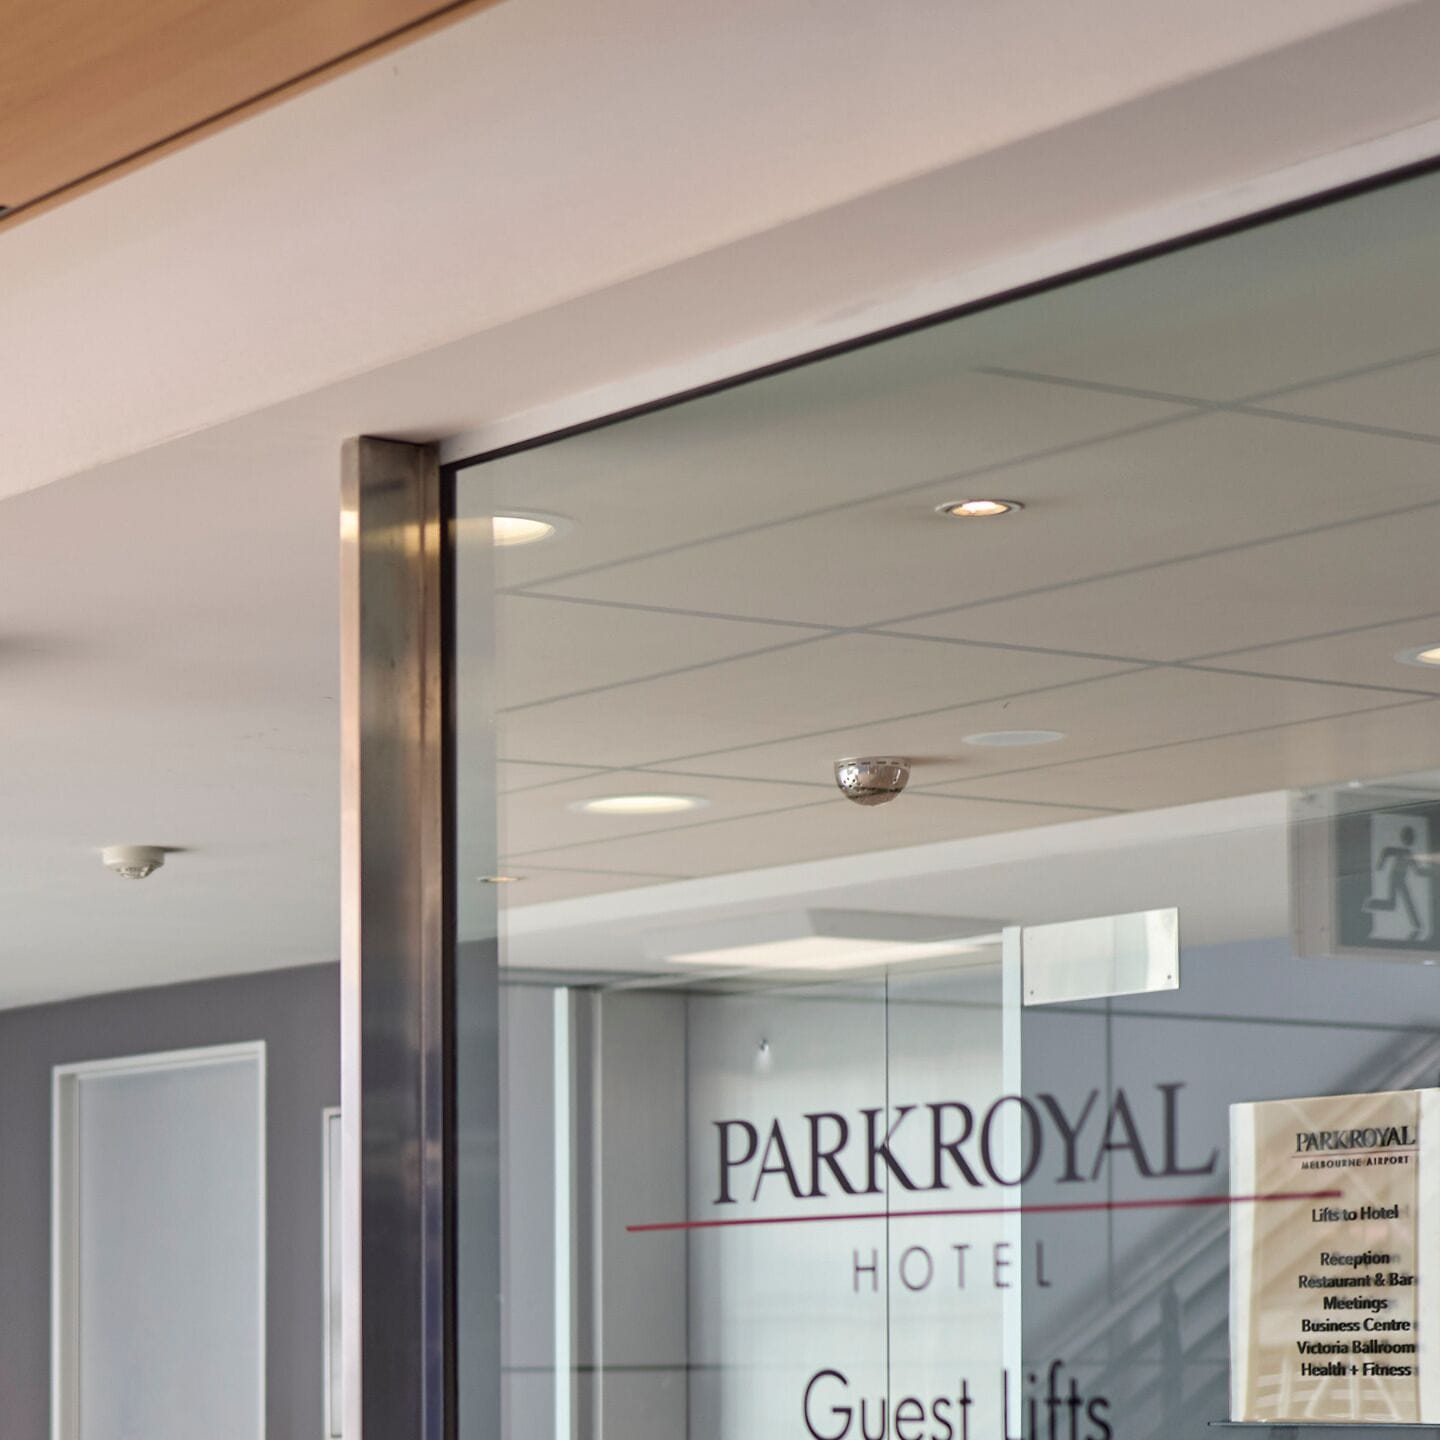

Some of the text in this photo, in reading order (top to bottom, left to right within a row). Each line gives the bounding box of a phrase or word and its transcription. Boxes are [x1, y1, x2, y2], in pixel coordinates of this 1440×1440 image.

[713, 1082, 1220, 1204] PARKROYAL
[1296, 1126, 1416, 1152] PARKROYAL
[1301, 1155, 1409, 1169] MELBOURNE AIRPORT
[1311, 1204, 1399, 1223] Lifts to Hotel
[852, 1240, 1053, 1293] HOTEL
[1320, 1250, 1391, 1269] Reception
[1298, 1272, 1414, 1288] Restaurant & Bar
[1323, 1295, 1389, 1313] Meetings
[1302, 1317, 1411, 1332] Business Centre
[1297, 1339, 1416, 1354] Victoria Ballroom
[1301, 1361, 1412, 1376] Health + Fitness
